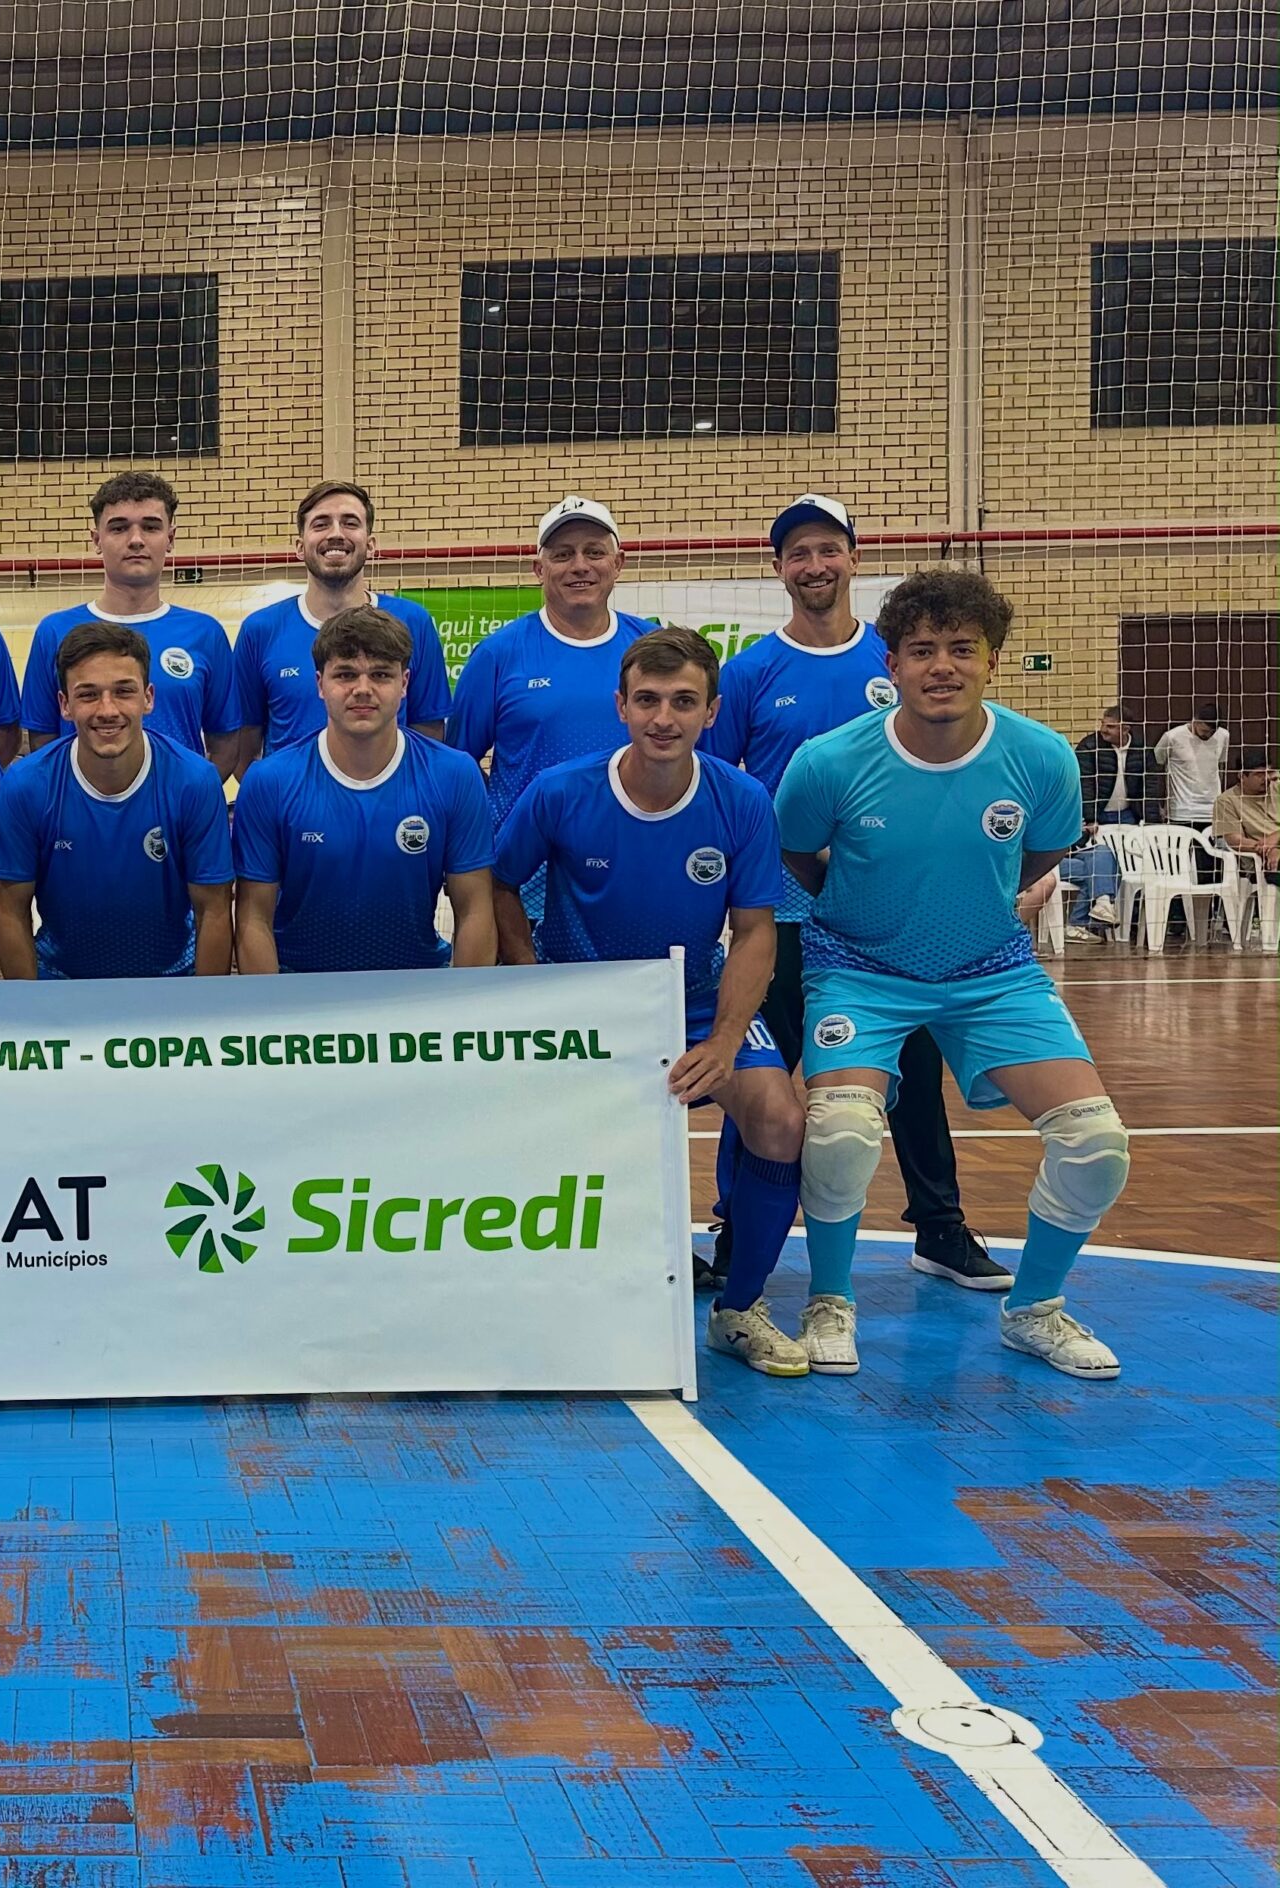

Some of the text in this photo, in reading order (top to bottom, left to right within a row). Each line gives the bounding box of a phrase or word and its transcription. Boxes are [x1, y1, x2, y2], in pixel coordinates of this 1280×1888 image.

[104, 1036, 212, 1068] COPA
[220, 1033, 378, 1065] SICREDI
[389, 1032, 443, 1062] DE
[453, 1029, 612, 1061] FUTSAL
[287, 1174, 605, 1253] Sicredi
[6, 1250, 108, 1271] Municípios
